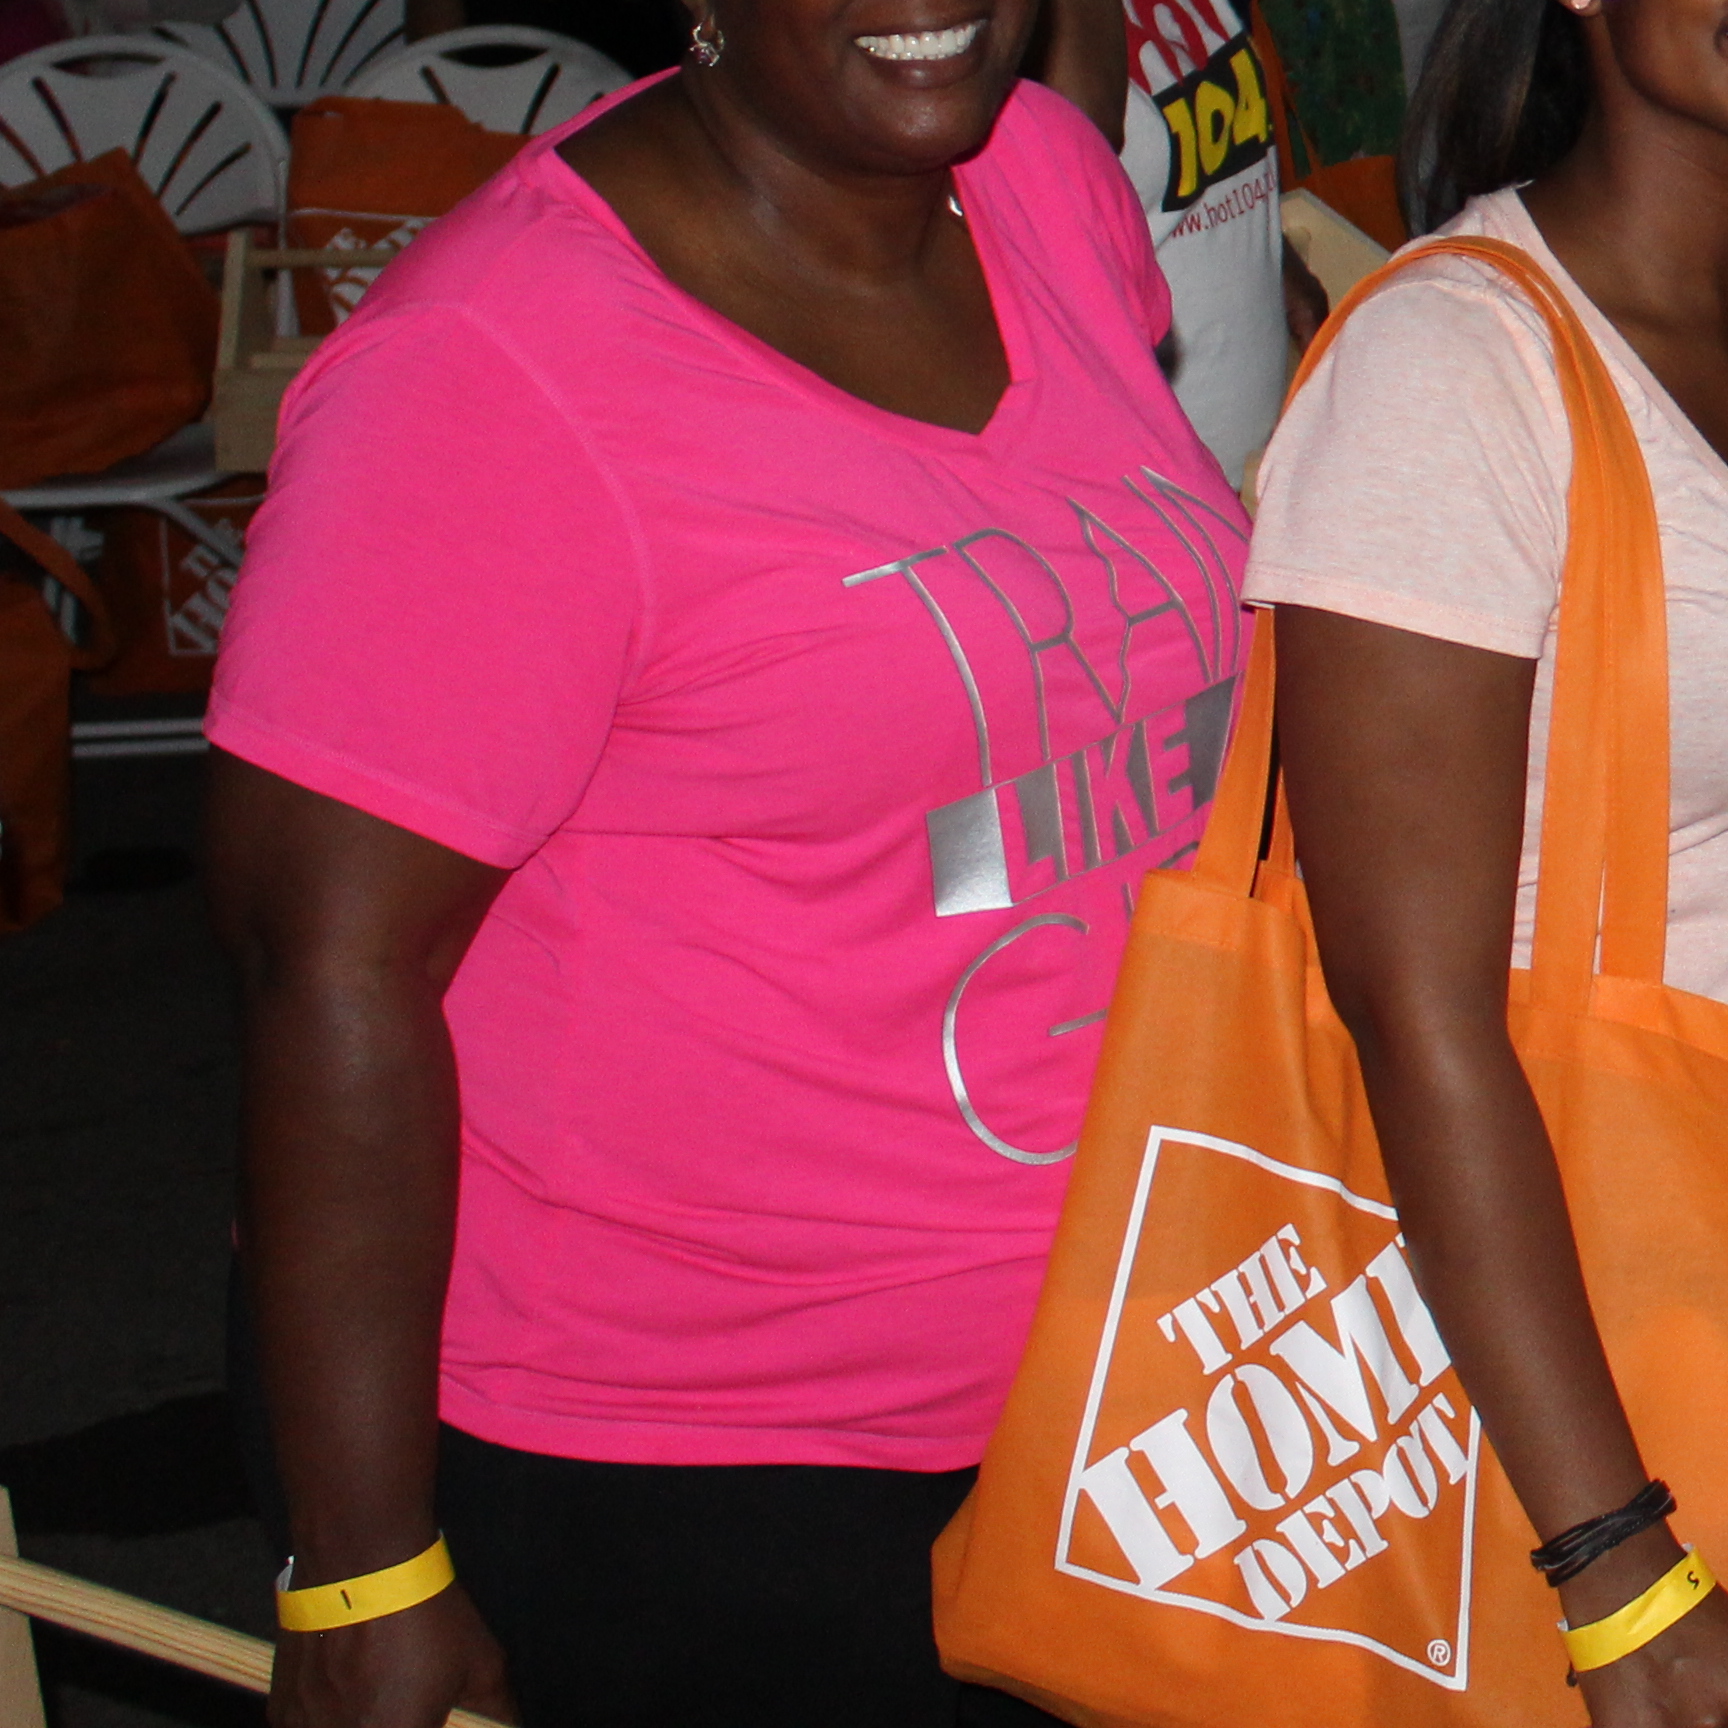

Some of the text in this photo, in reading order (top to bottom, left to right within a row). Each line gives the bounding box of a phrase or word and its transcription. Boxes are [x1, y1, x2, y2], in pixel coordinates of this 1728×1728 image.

[994, 720, 1196, 904] LIKE
[1156, 1222, 1328, 1376] THE
[1233, 1392, 1470, 1623] DEPOT
